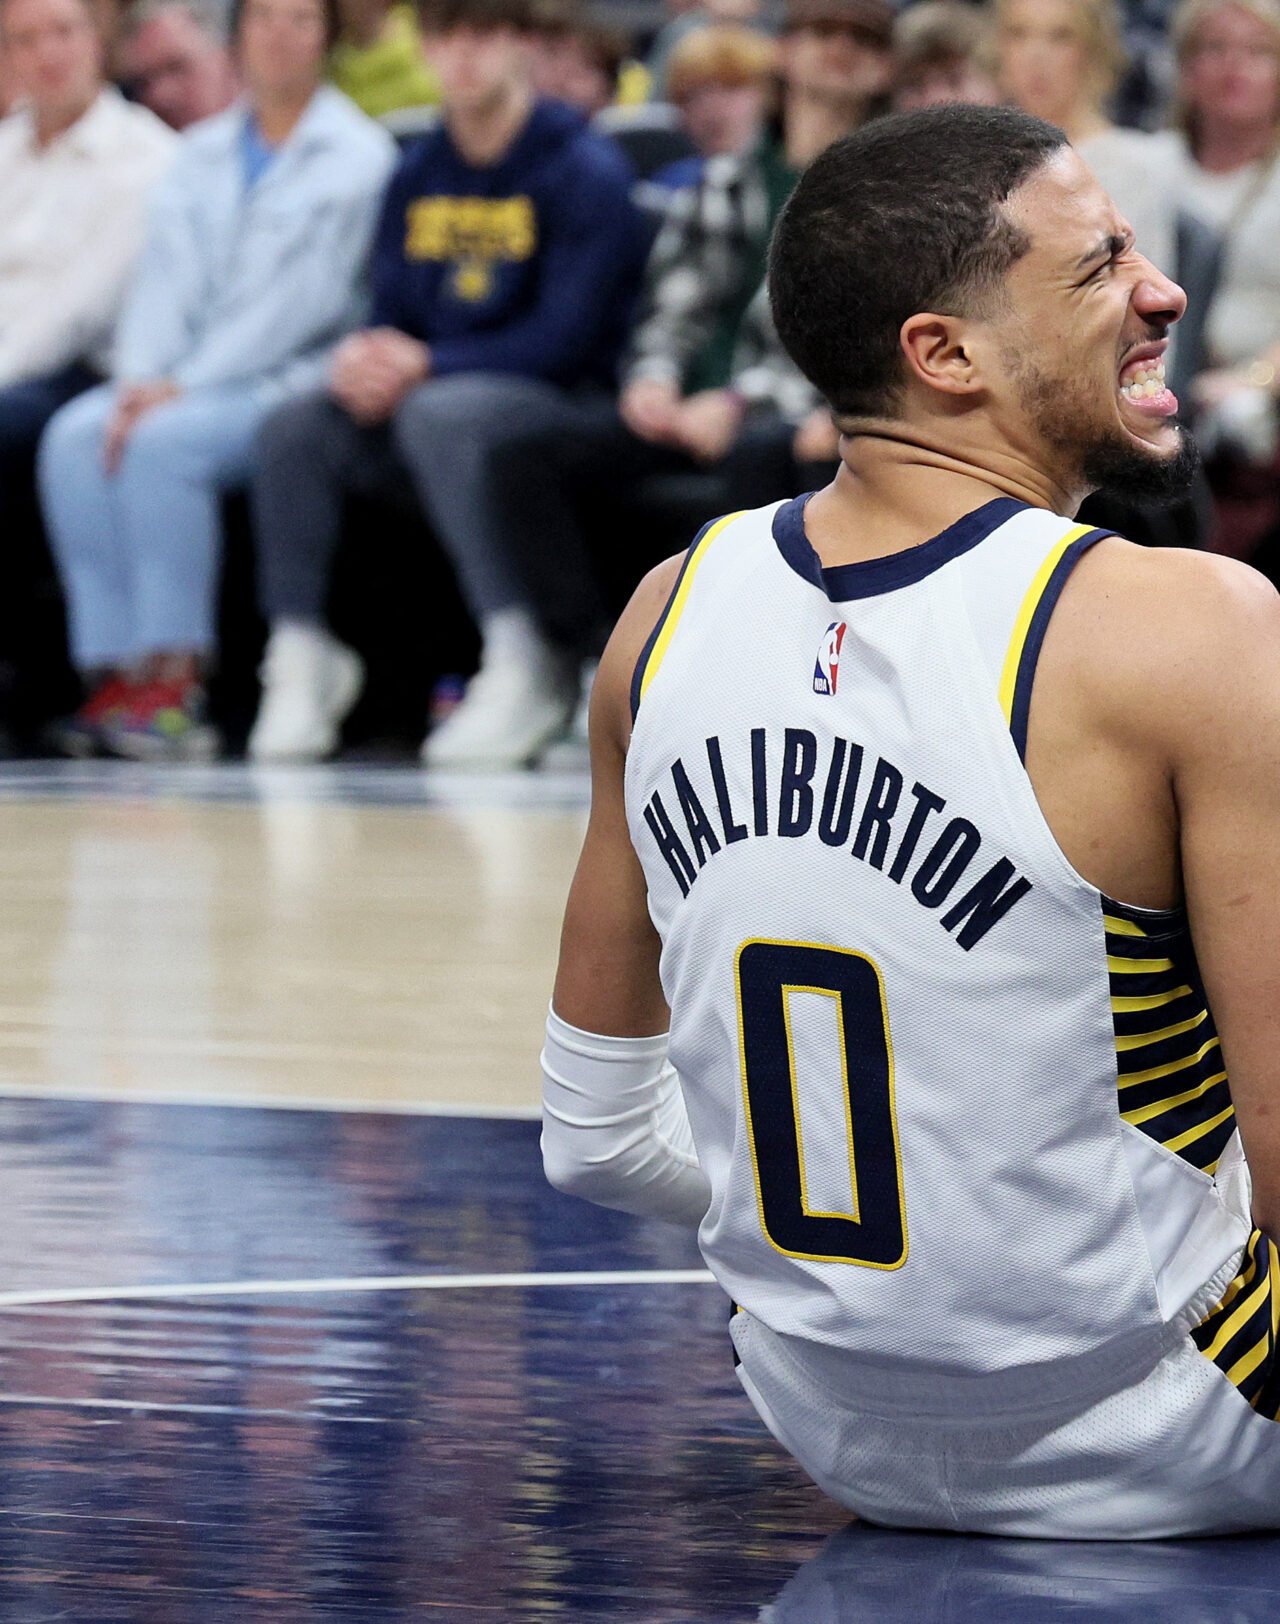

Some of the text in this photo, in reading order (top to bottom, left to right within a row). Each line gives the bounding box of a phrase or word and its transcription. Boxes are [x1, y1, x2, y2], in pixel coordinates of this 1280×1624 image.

[814, 677, 828, 692] NBA
[643, 728, 1033, 951] HALIBURTON
[734, 937, 909, 1270] 0
